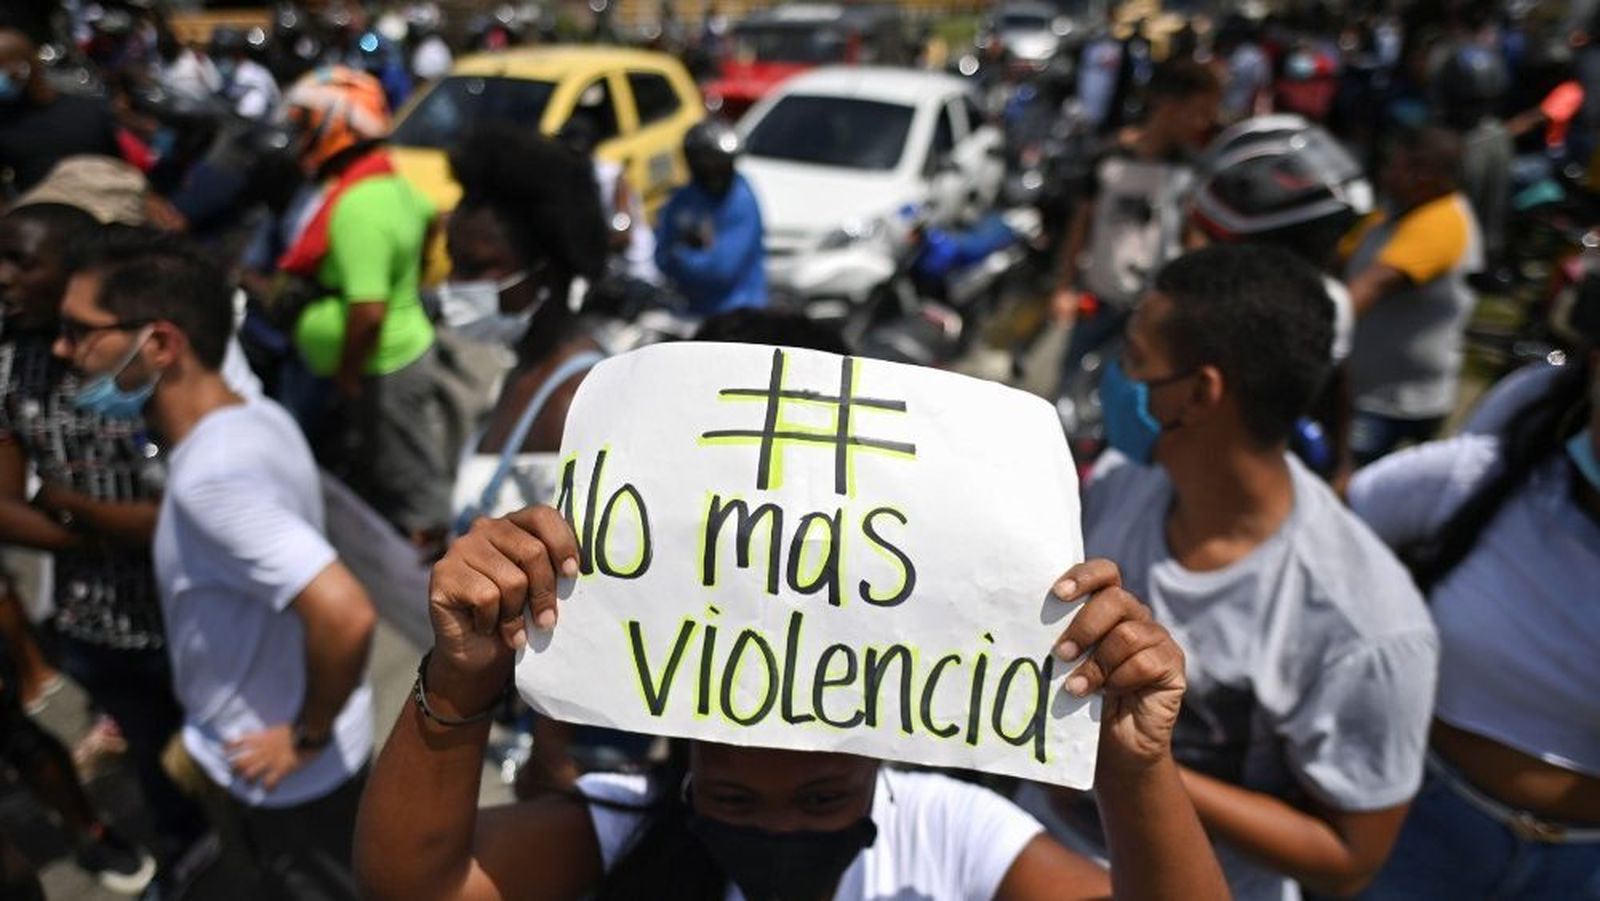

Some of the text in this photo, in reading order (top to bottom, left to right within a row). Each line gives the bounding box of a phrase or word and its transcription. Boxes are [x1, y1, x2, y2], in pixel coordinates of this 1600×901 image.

[702, 348, 916, 494] #
[556, 449, 916, 607] No mas
